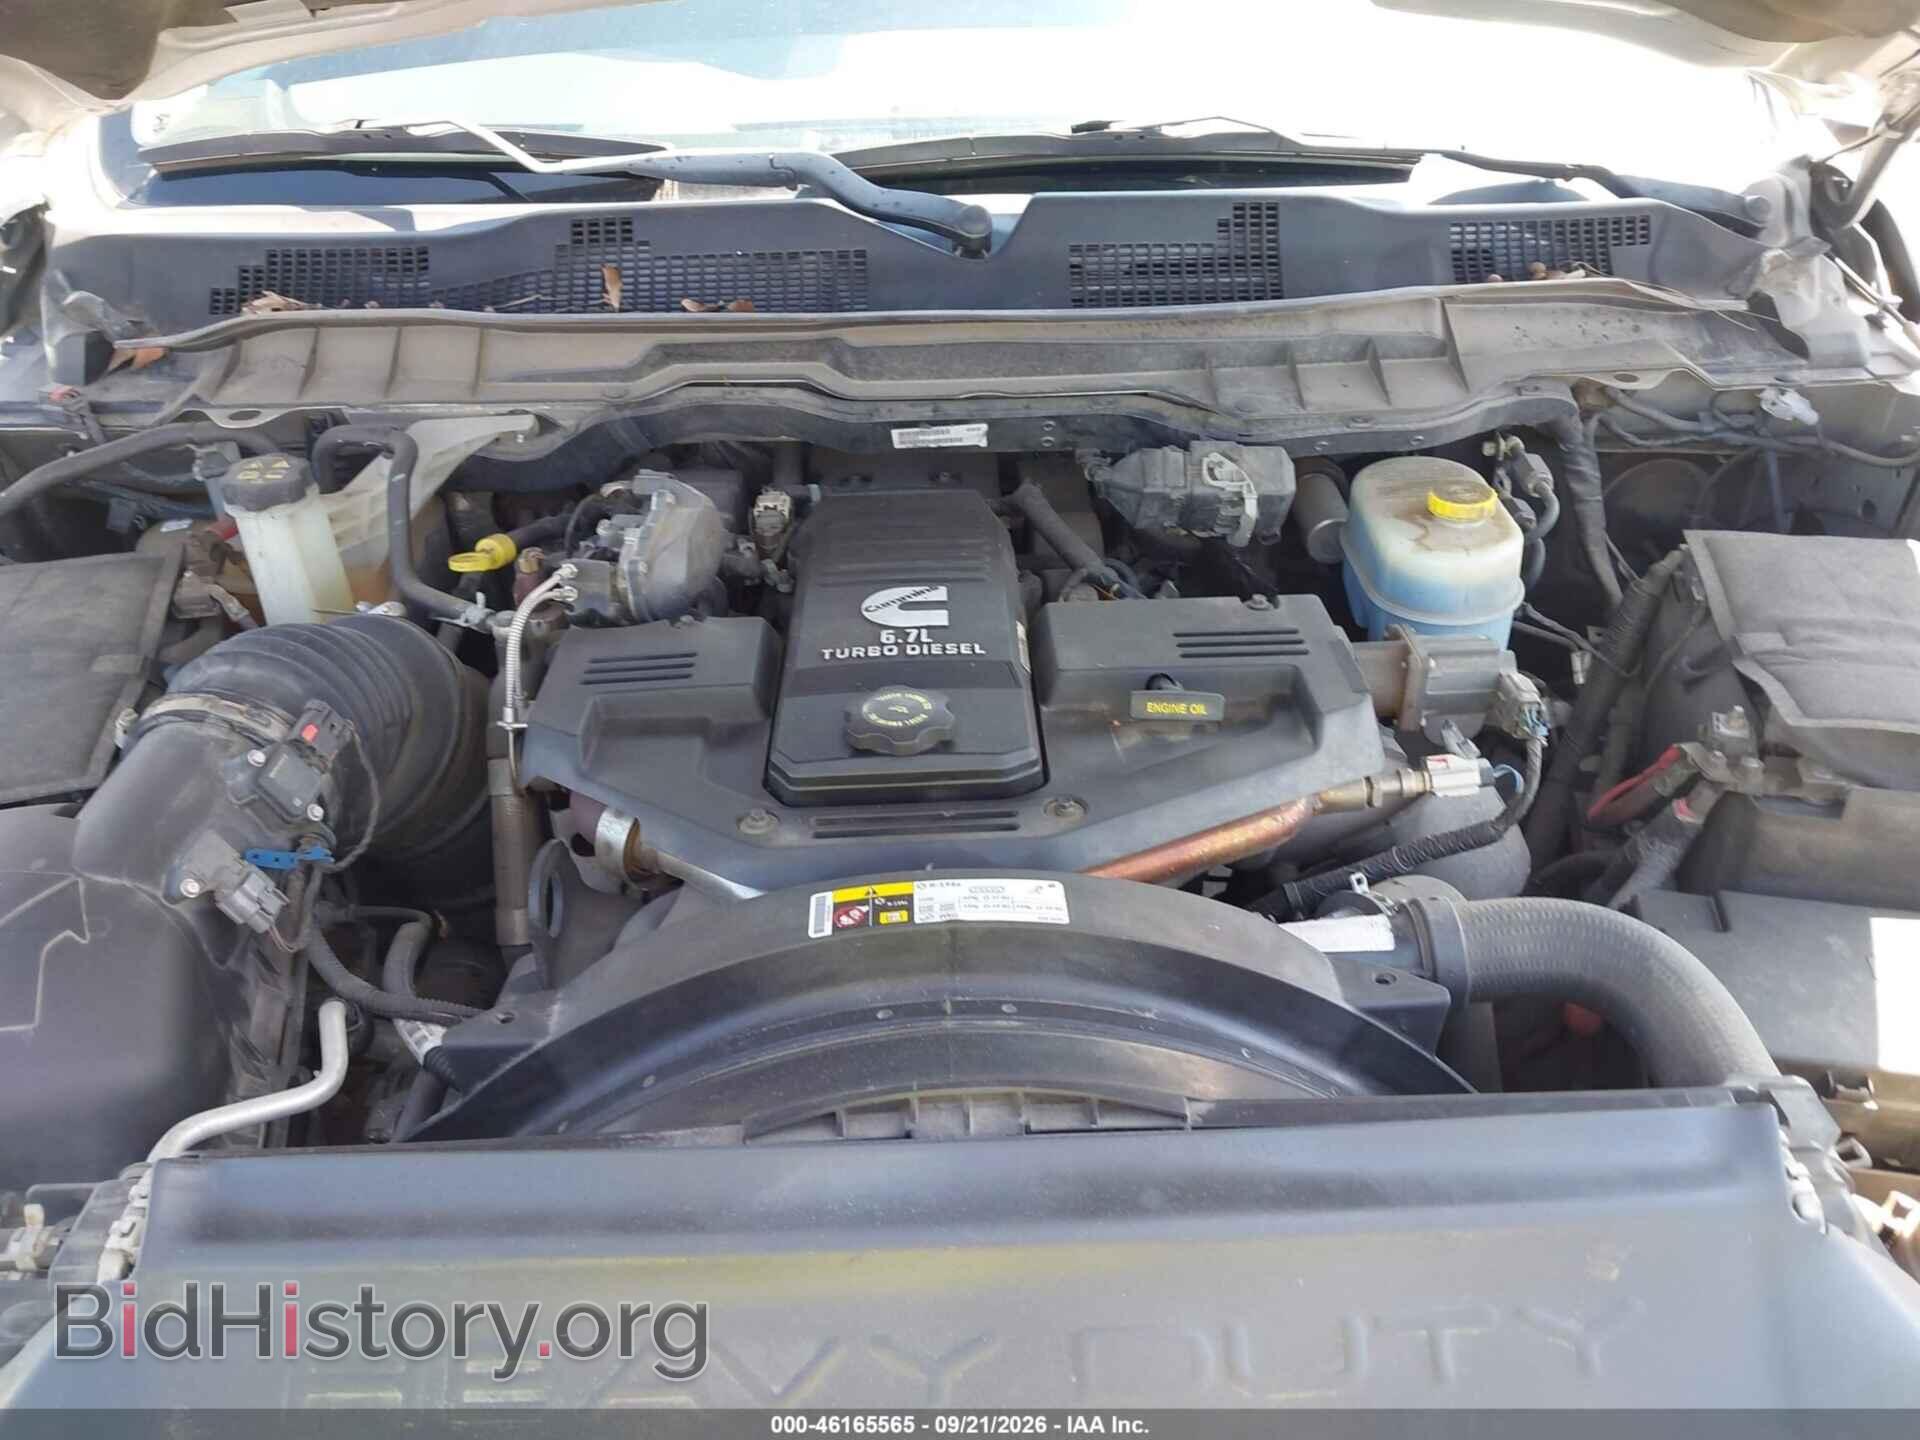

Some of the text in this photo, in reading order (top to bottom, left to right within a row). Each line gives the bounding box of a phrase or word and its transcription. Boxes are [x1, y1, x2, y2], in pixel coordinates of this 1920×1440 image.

[880, 628, 933, 644] 6.7L
[822, 643, 987, 660] TURBO DIESEL
[1146, 702, 1208, 716] ENGINE OIL
